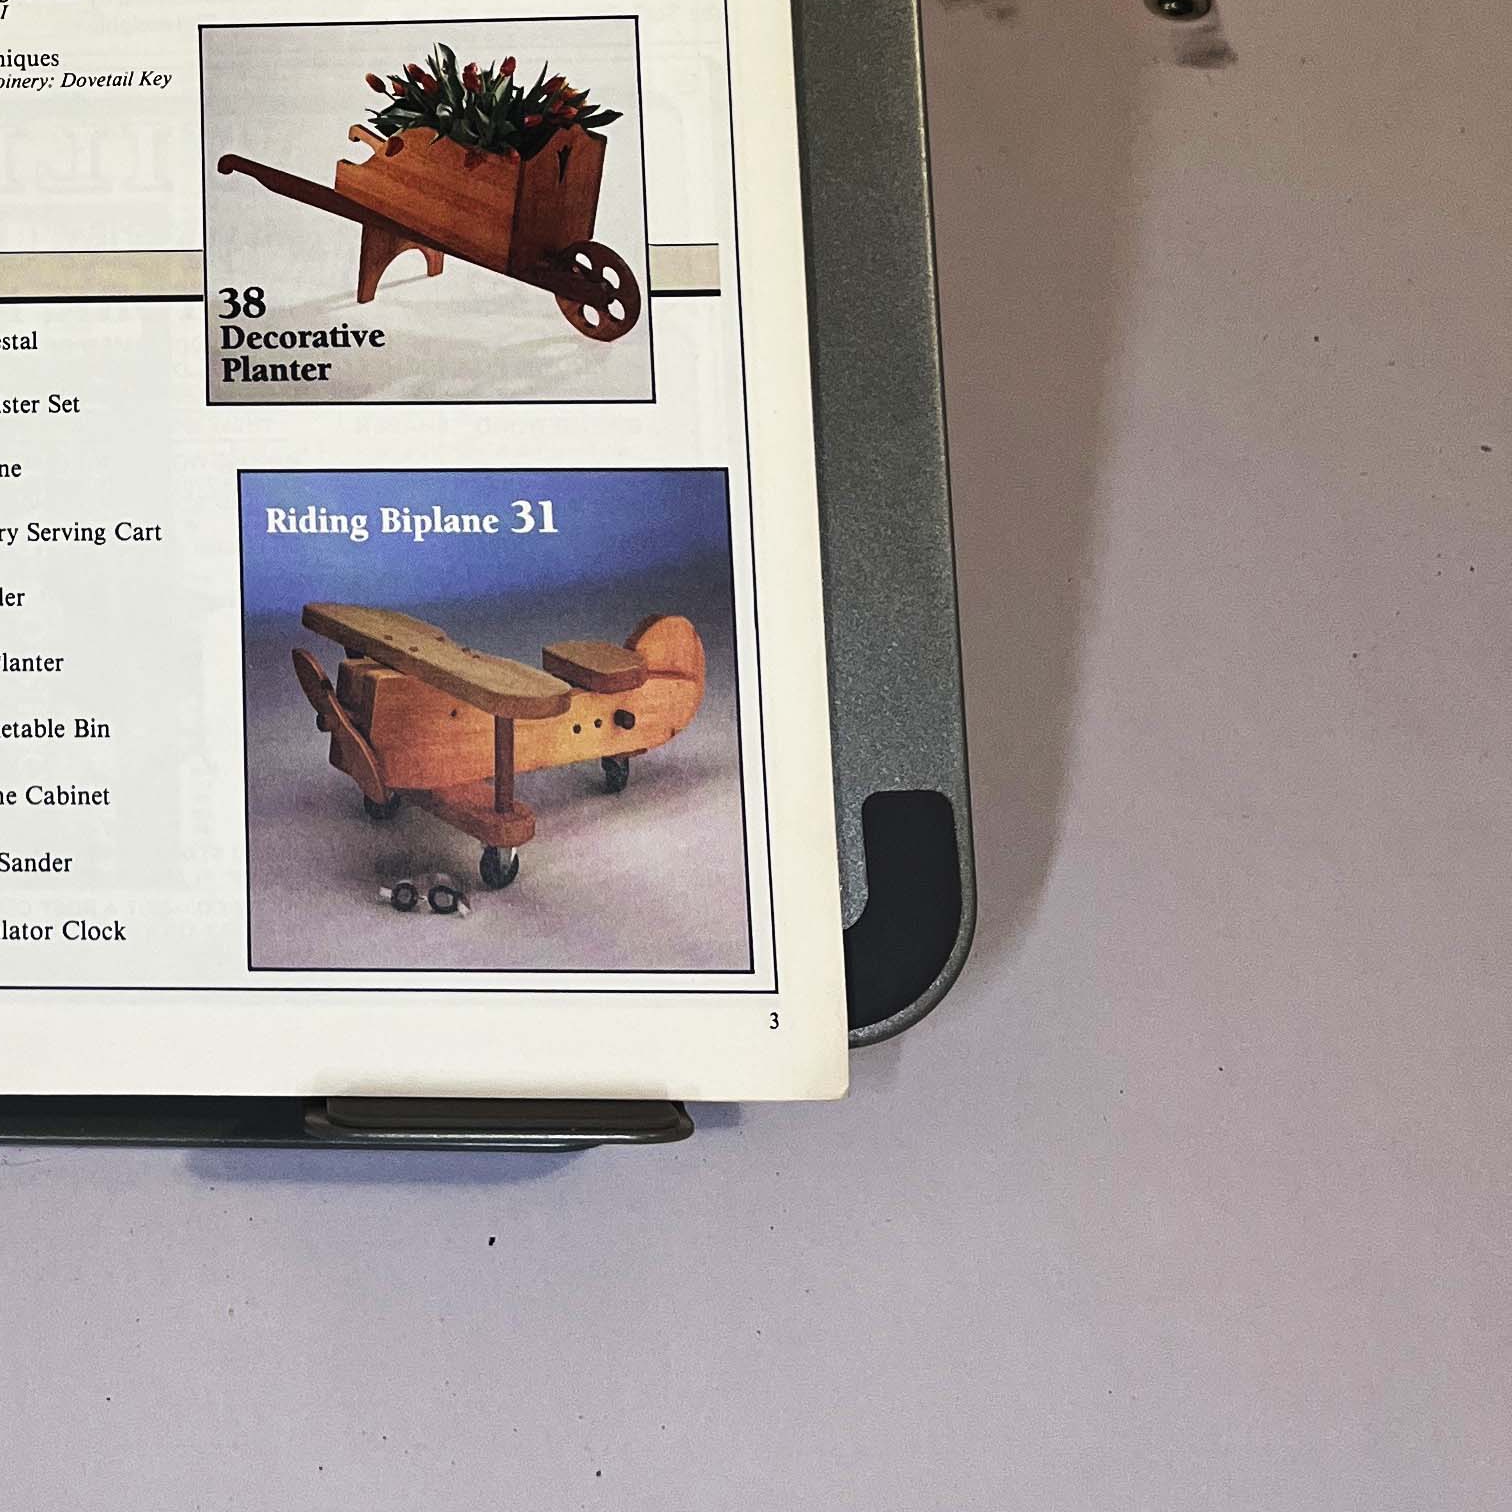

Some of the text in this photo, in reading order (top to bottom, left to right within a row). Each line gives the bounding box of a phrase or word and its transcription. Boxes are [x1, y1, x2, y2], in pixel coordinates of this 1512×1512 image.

[0, 4, 10, 21] I
[59, 70, 135, 89] Dovetail
[138, 70, 173, 90] Key
[217, 286, 267, 320] 38
[219, 322, 386, 351] Decorative
[220, 354, 333, 383] Planter
[48, 393, 81, 414] Set
[265, 499, 559, 543] Riding Biplane 31
[26, 521, 107, 546] Serving
[114, 521, 163, 542] Cart
[73, 717, 111, 739] Bin
[25, 784, 111, 806] Cabinet
[61, 919, 127, 942] Clock
[769, 1011, 780, 1030] 3
